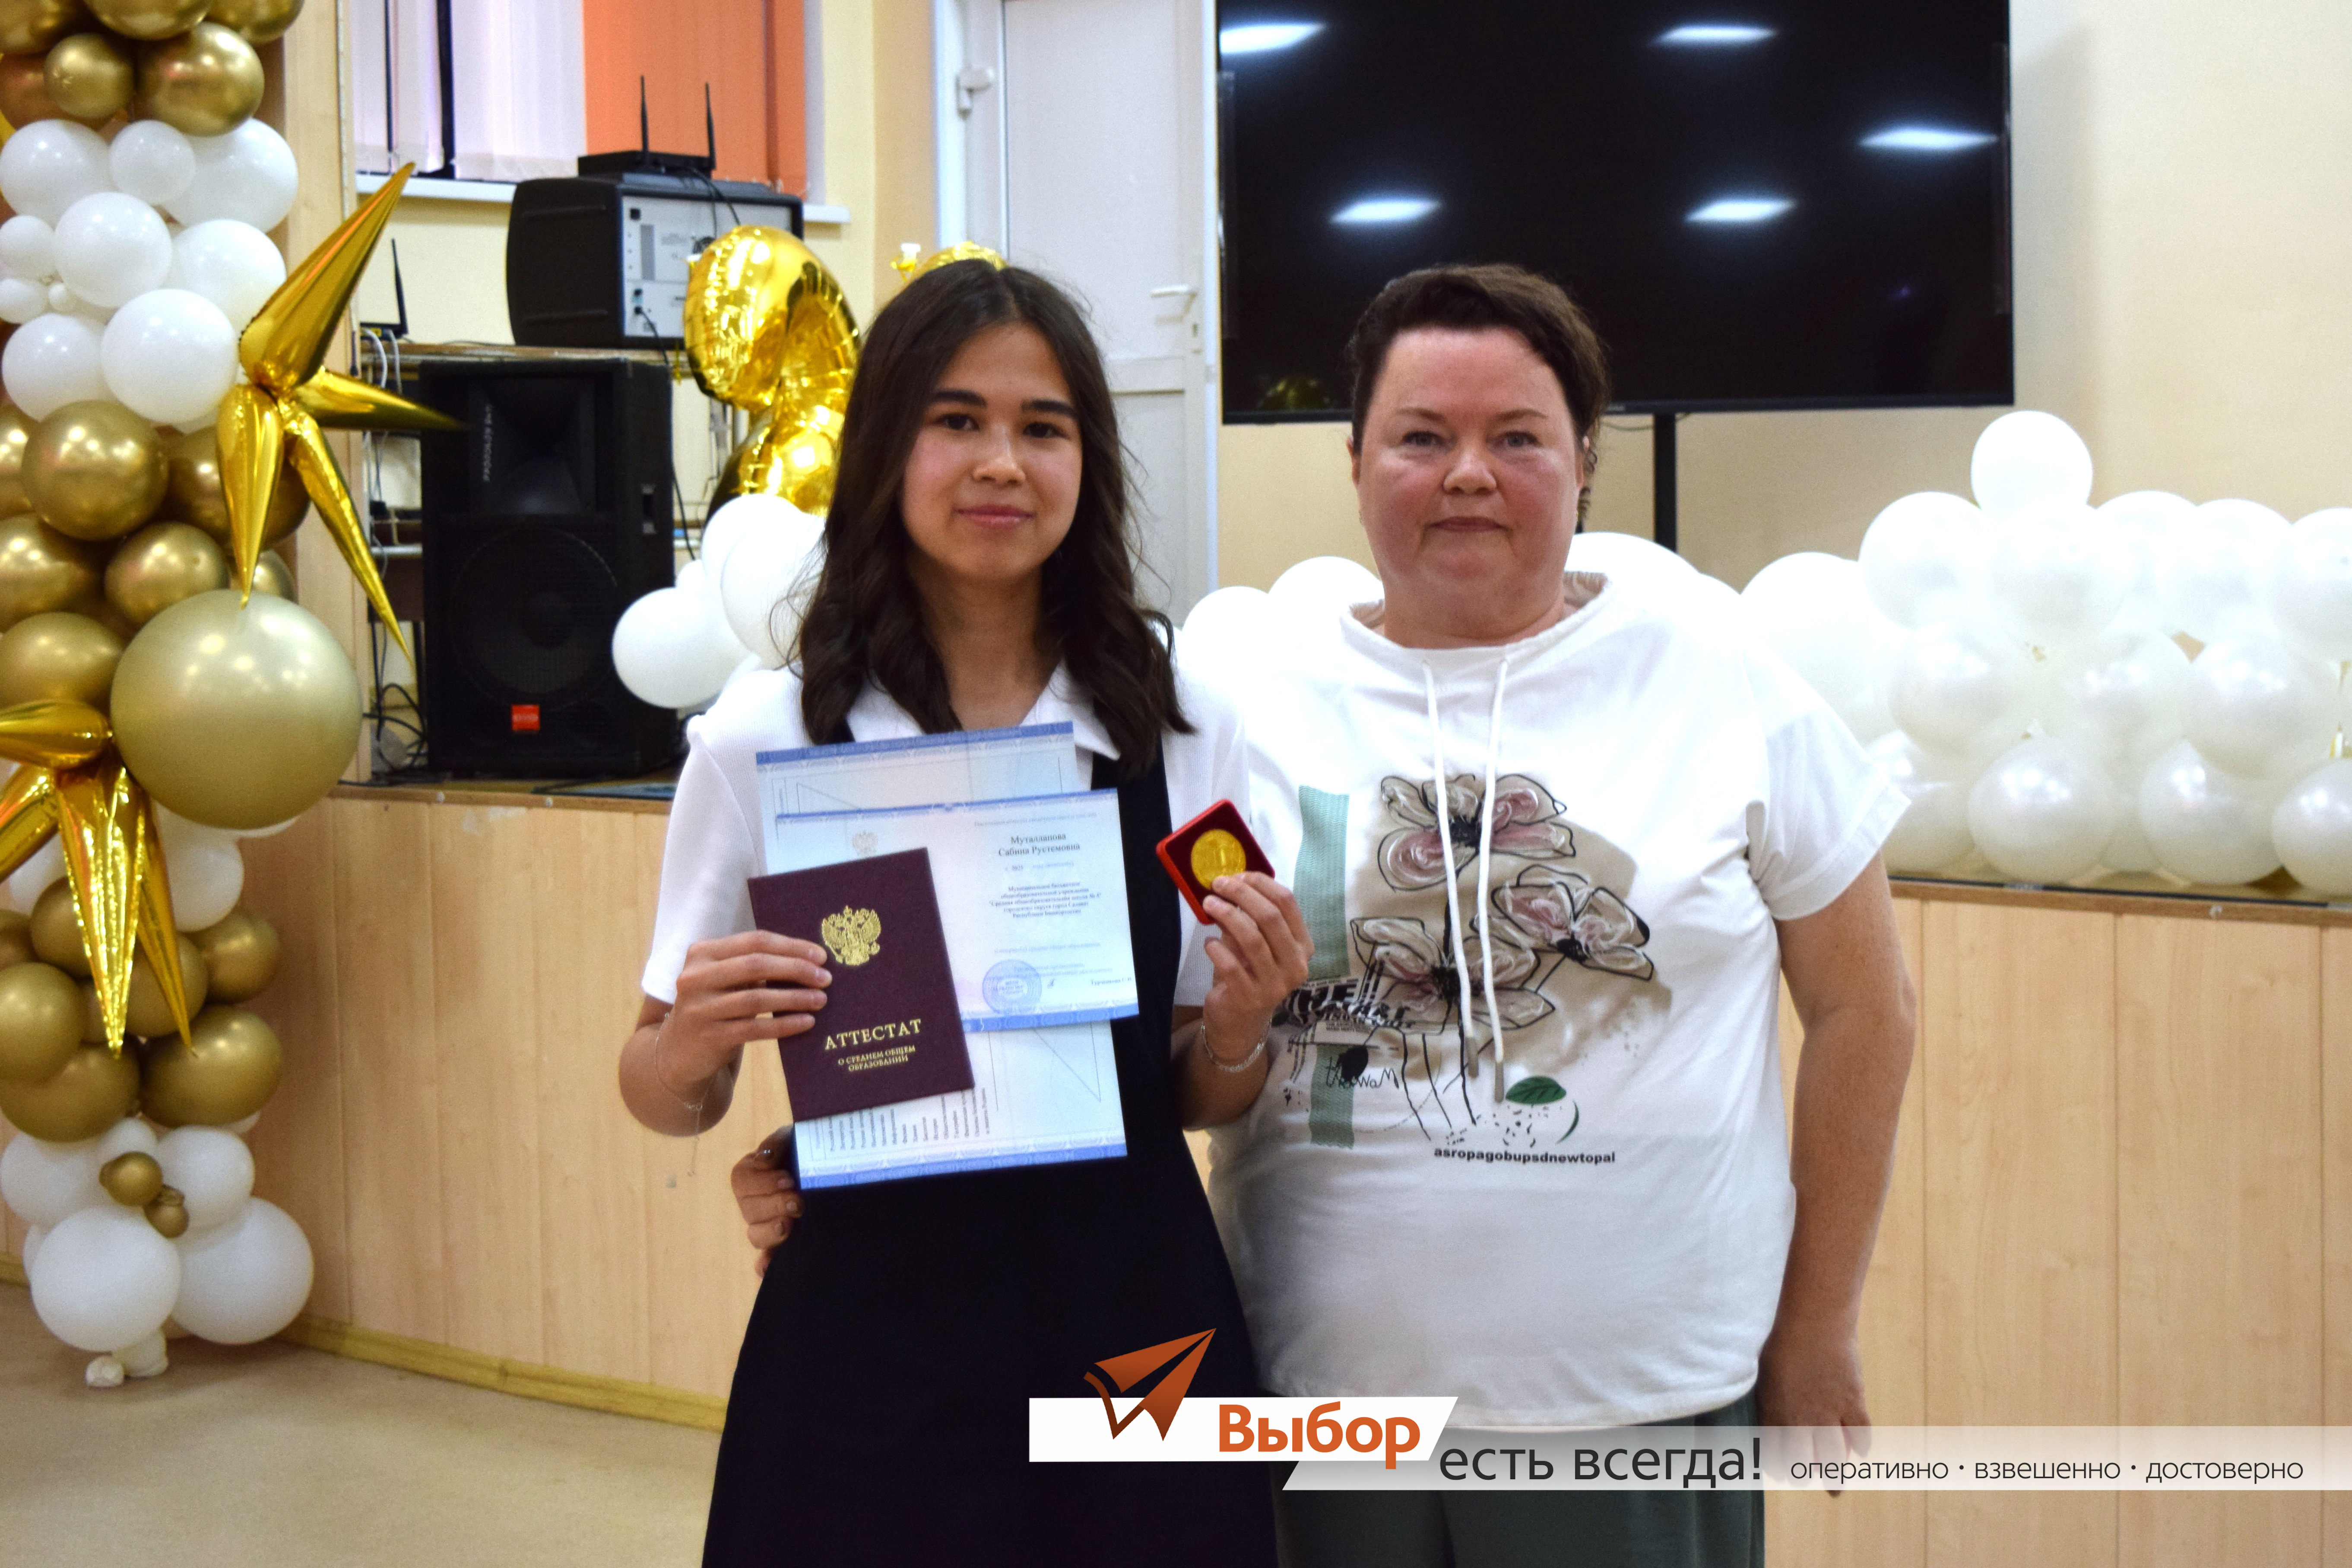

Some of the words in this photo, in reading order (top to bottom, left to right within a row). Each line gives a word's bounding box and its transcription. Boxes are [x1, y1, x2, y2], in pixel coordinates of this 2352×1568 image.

[998, 846, 1029, 856] Сабина
[1032, 843, 1080, 855] Рустемовна
[825, 1019, 921, 1050] АТТЕСТАТ
[846, 1051, 884, 1064] СРЕДНЕМ
[885, 1045, 916, 1057] ОБЩЕМ
[849, 1055, 908, 1072] ОБРАЗОВАНИИ
[1434, 1147, 1615, 1165] asropagobupsdnewtopal
